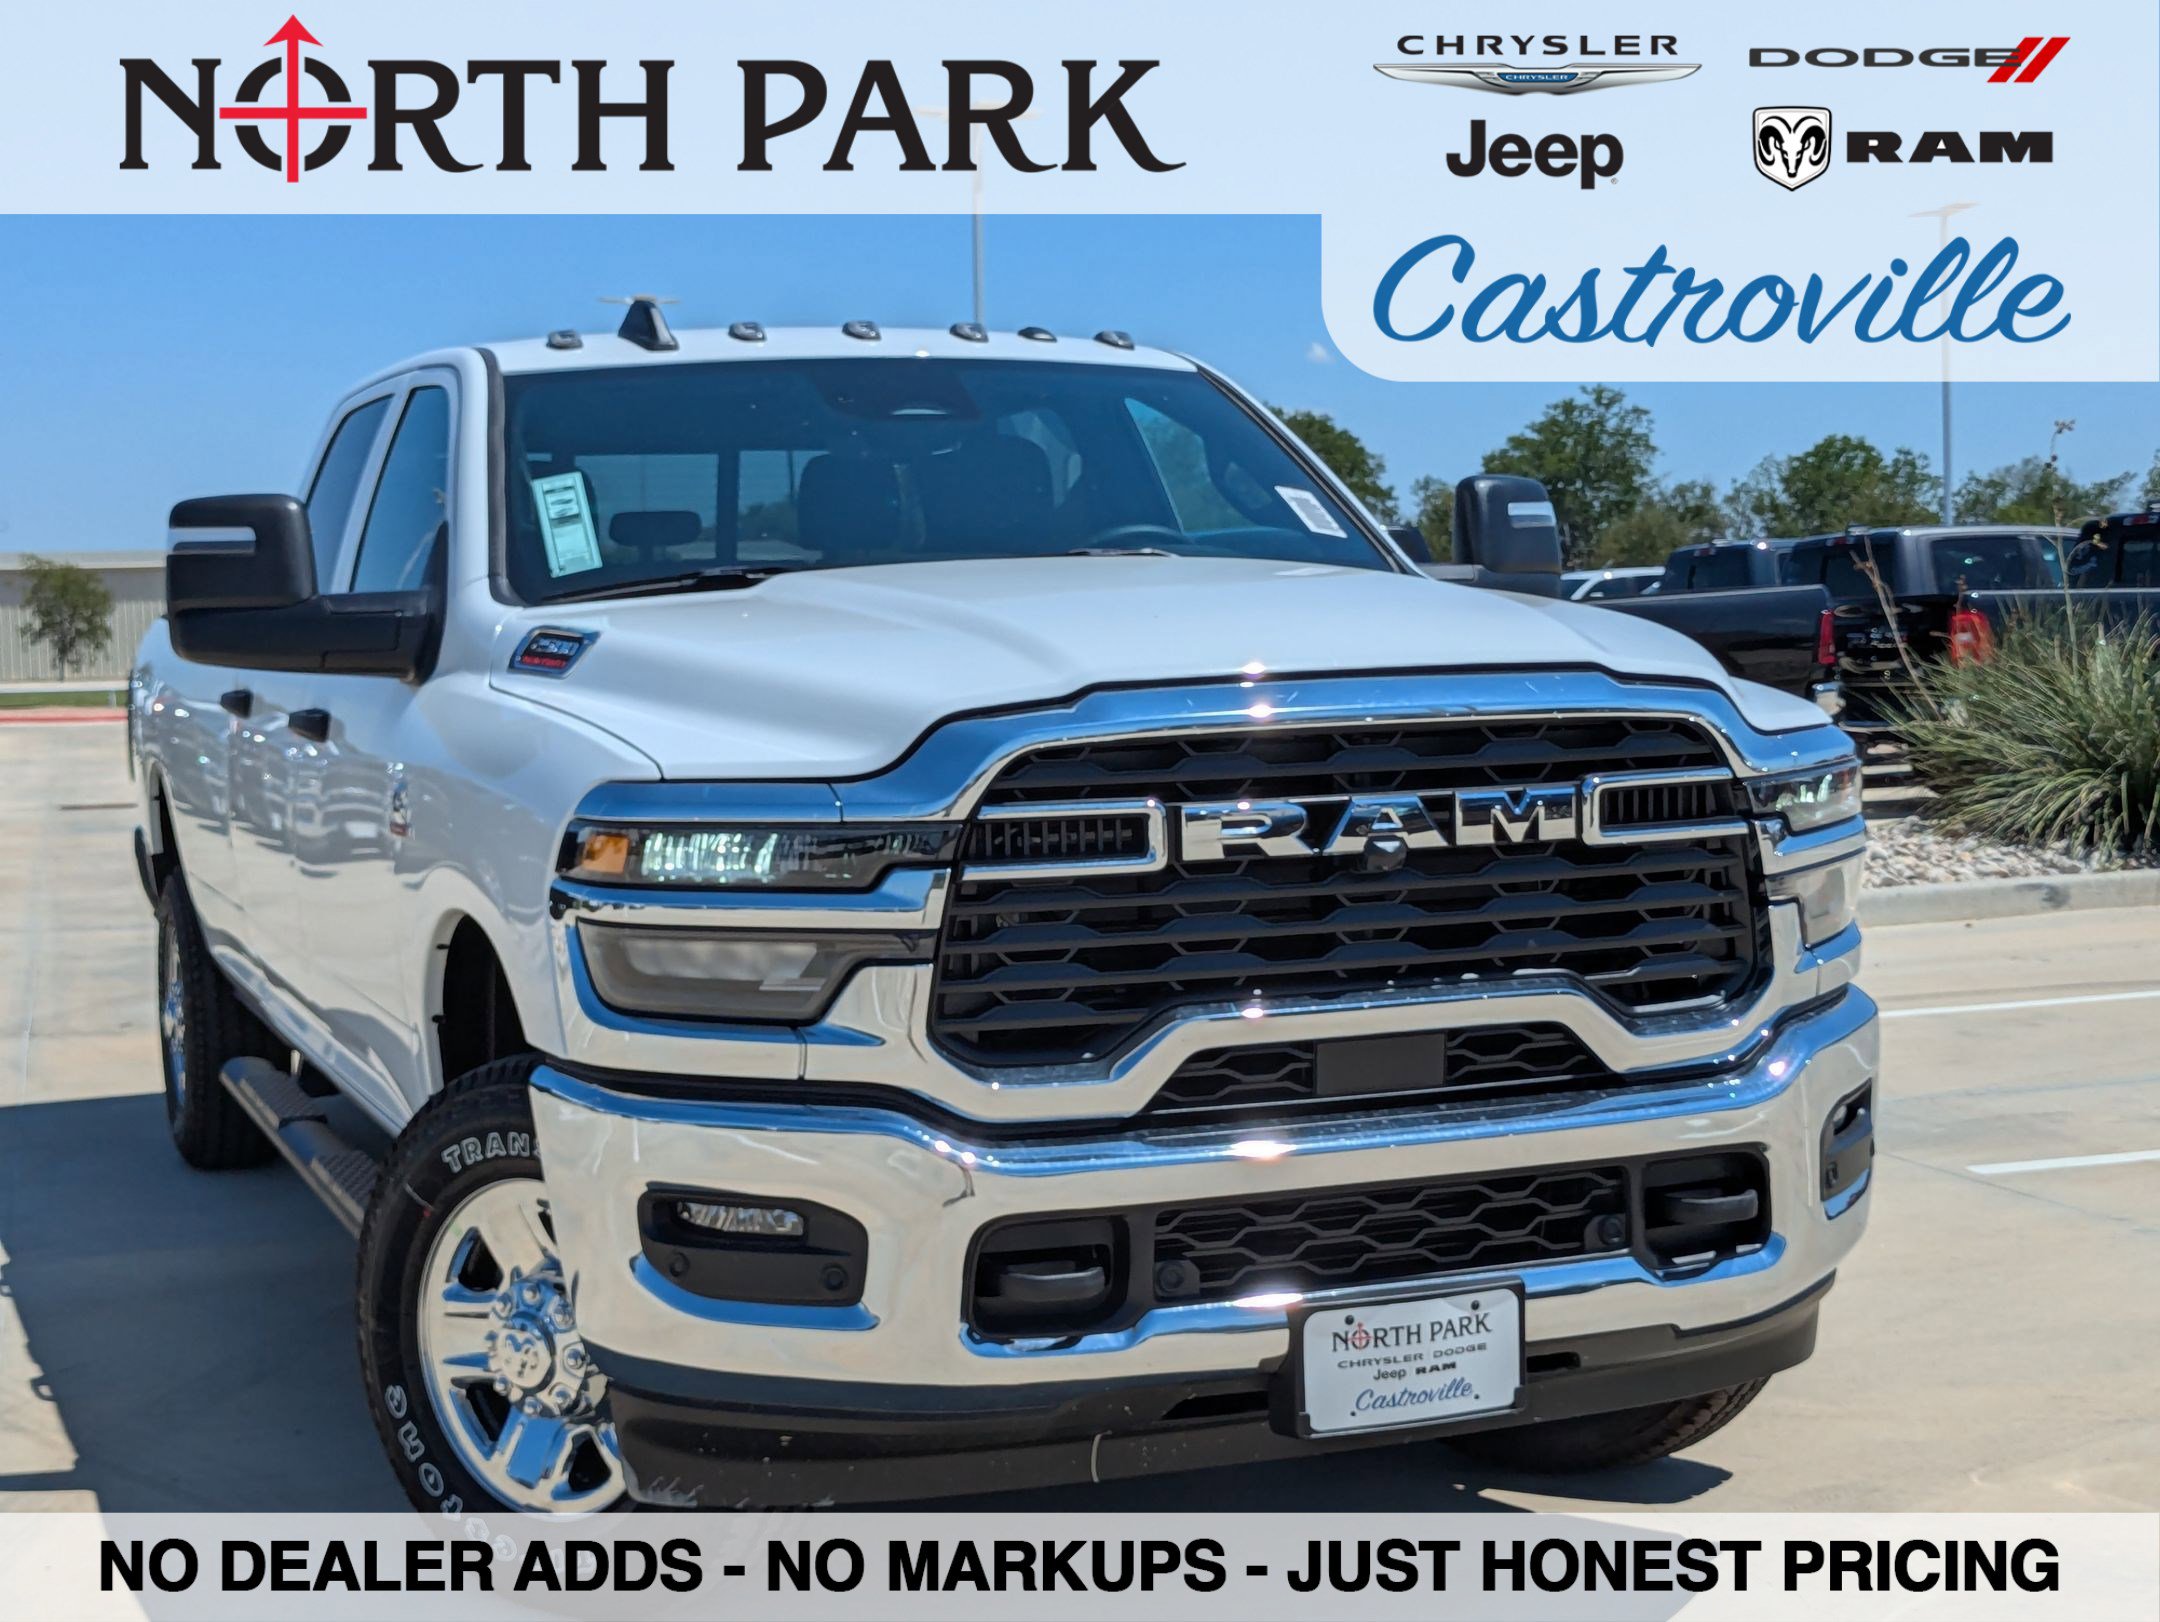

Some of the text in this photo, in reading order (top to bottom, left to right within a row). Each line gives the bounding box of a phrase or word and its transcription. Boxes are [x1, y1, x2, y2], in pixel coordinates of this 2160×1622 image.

[1181, 782, 1578, 862] RAM
[1331, 1312, 1493, 1353] NORTH PARK
[1337, 1342, 1488, 1369] CHRYSLER DODGE
[1373, 1361, 1457, 1382] Jeep RAM
[1355, 1376, 1473, 1412] Castroville
